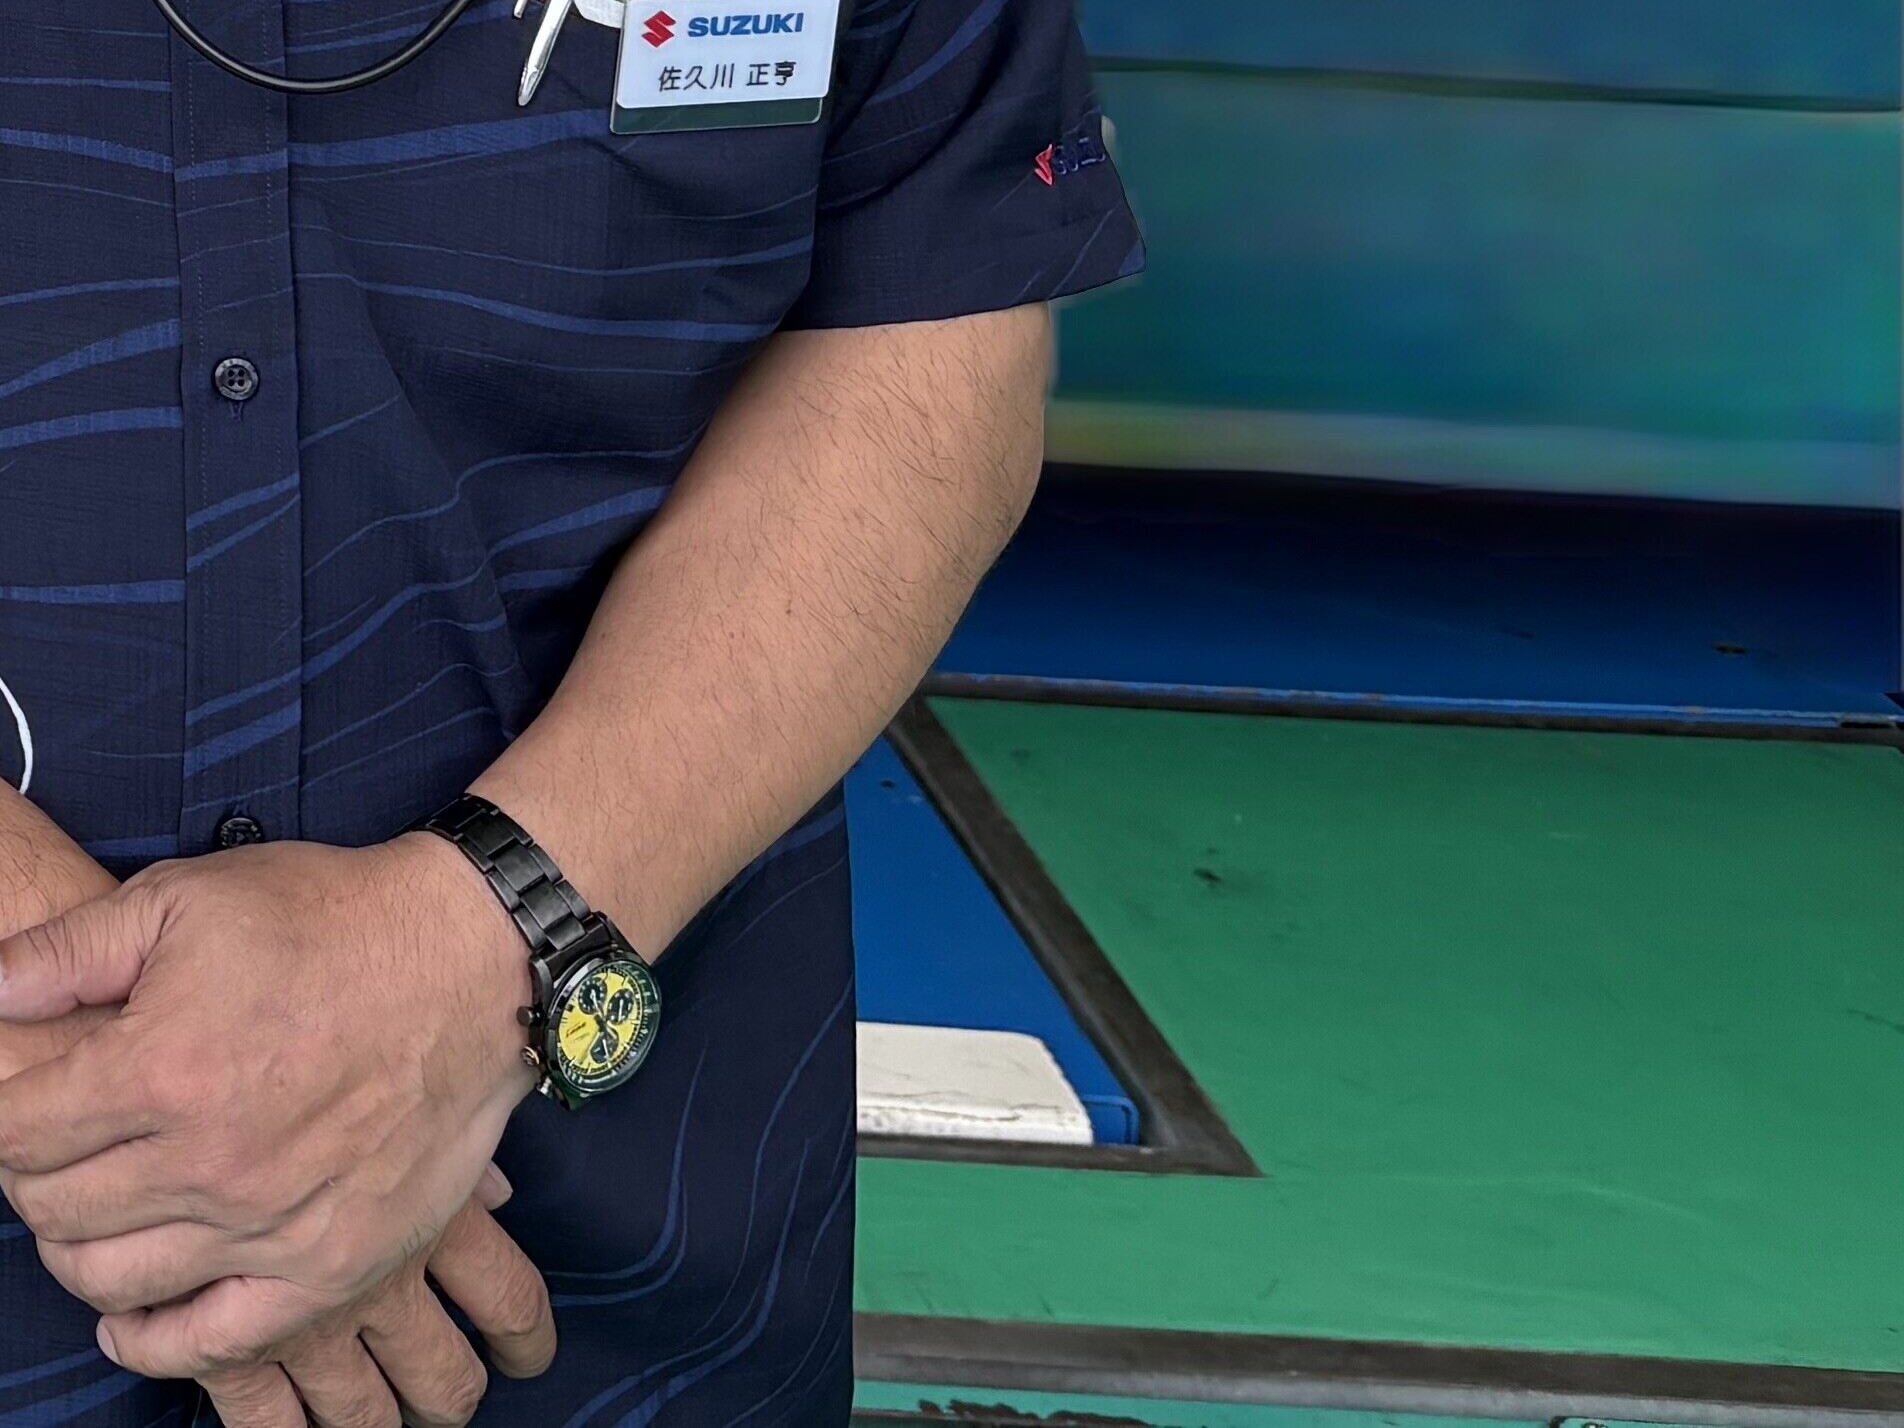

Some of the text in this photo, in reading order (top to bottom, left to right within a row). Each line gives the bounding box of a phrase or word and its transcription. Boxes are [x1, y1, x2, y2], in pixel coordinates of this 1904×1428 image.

[687, 12, 804, 38] SUZUKI
[658, 63, 736, 92] 佐久川
